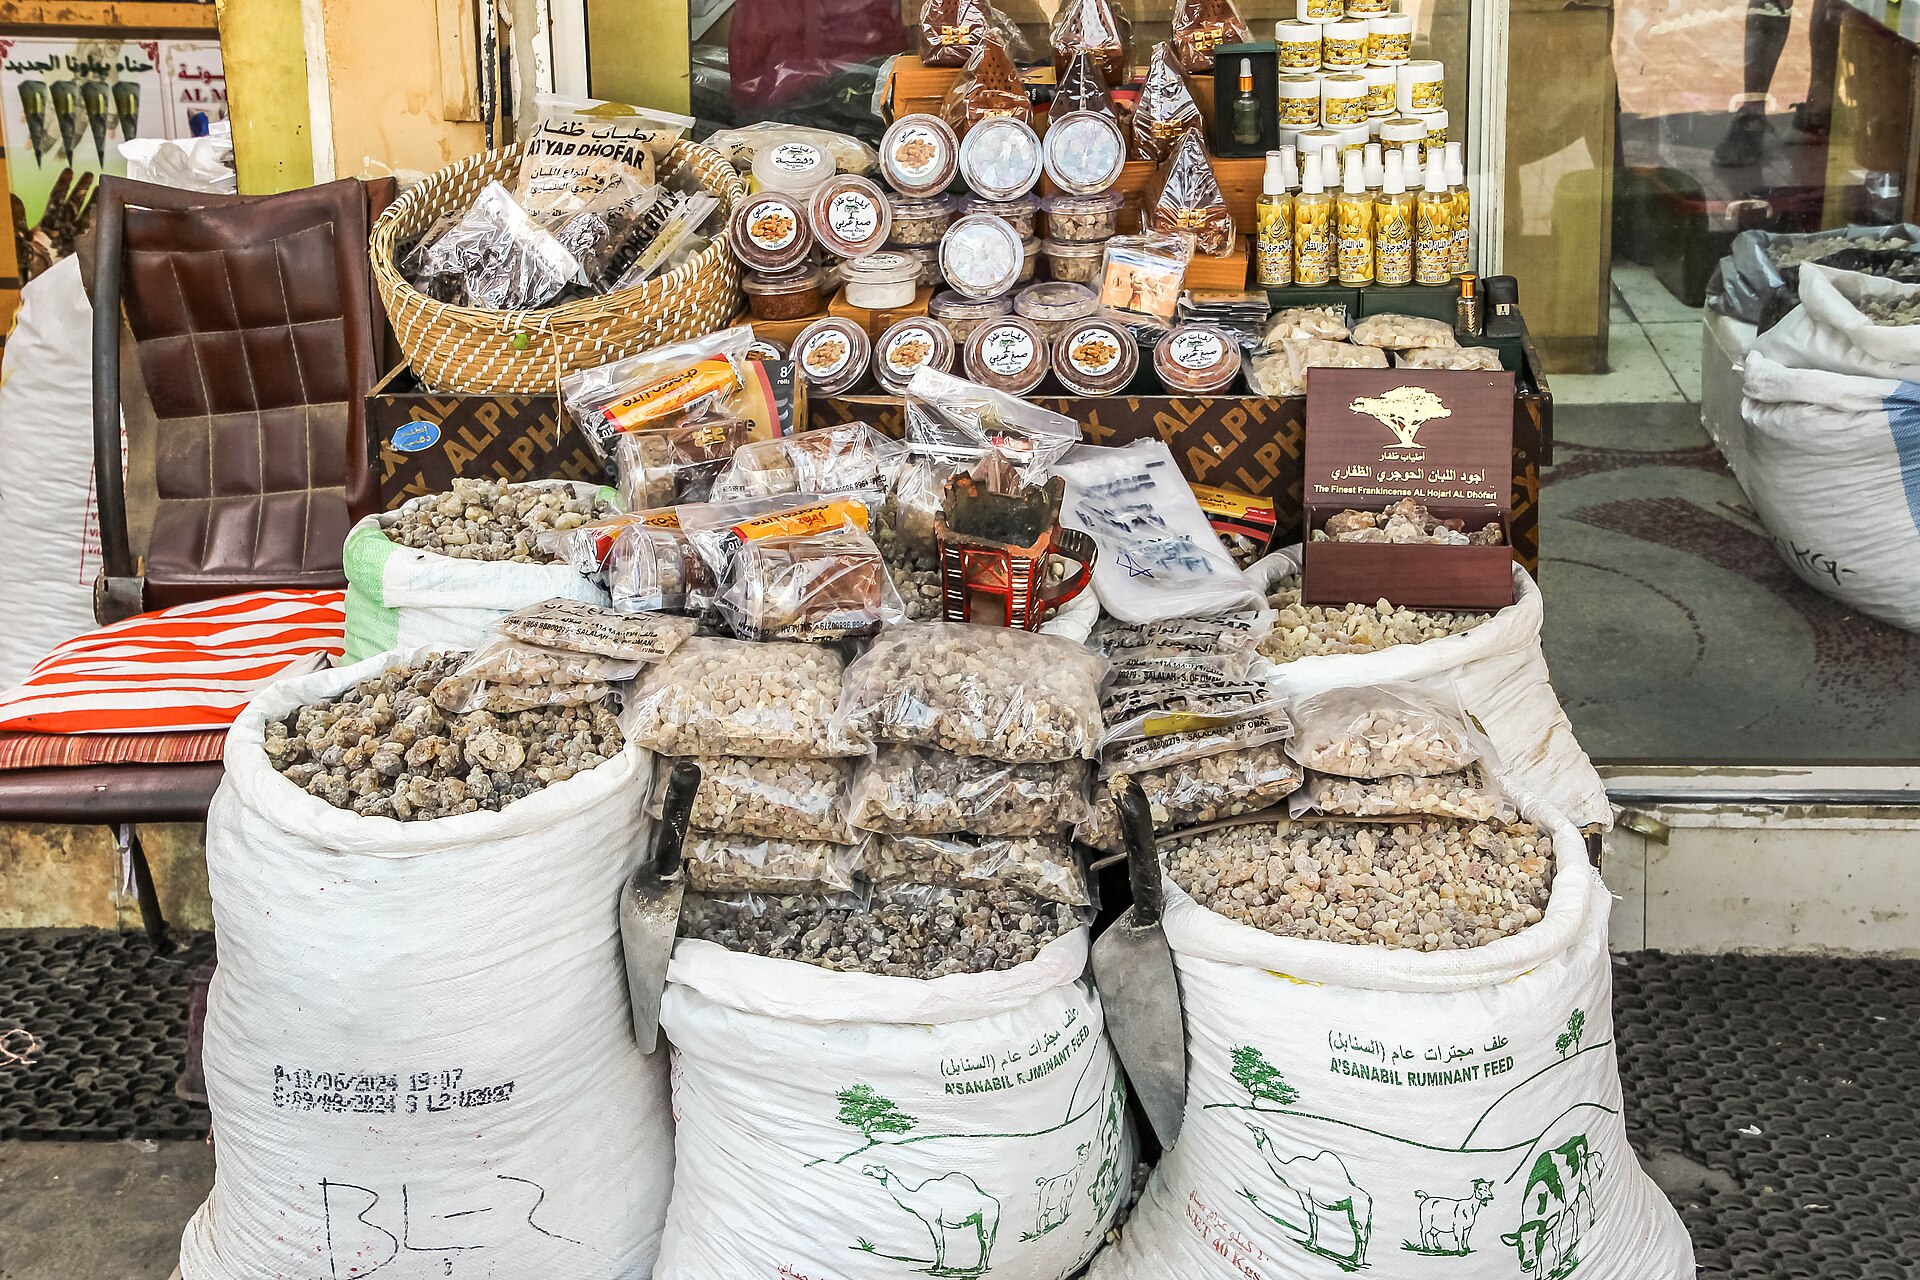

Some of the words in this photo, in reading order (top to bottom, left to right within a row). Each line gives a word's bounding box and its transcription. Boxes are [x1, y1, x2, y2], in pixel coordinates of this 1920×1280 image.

[180, 88, 207, 103] AL
[532, 119, 586, 138] ظفار
[576, 142, 645, 171] DHOFAR
[530, 167, 561, 180] اللبان
[562, 165, 589, 178] أنواع
[780, 367, 788, 378] 8
[1379, 451, 1401, 462] ظفار
[1400, 451, 1425, 463] أطياب
[1330, 464, 1372, 481] الظفاري
[1376, 467, 1424, 483] الحوجري
[1427, 468, 1456, 483] اللبان
[1460, 468, 1485, 485] أجود
[1314, 485, 1329, 494] The
[1331, 485, 1357, 494] Finest
[1358, 486, 1412, 496] Frankincense
[1453, 490, 1464, 498] AL
[1143, 671, 1177, 681] SALALAH
[1187, 727, 1223, 742] SALALAH
[1236, 722, 1247, 732] OF
[1247, 718, 1271, 731] OMAN
[1028, 1029, 1062, 1057] مجترات
[1483, 1034, 1510, 1053] علف
[944, 1075, 1015, 1095] A'SANABIL
[1070, 1024, 1091, 1053] FEED
[1000, 1050, 1022, 1071] عام
[1391, 1044, 1415, 1065] عام
[1424, 1045, 1474, 1064] مجترات
[1329, 1057, 1404, 1086] A'SANABIL
[1407, 1065, 1480, 1087] RUMINANT
[1483, 1055, 1515, 1078] FEED
[1185, 1203, 1211, 1239] NET
[1212, 1238, 1229, 1258] 40
